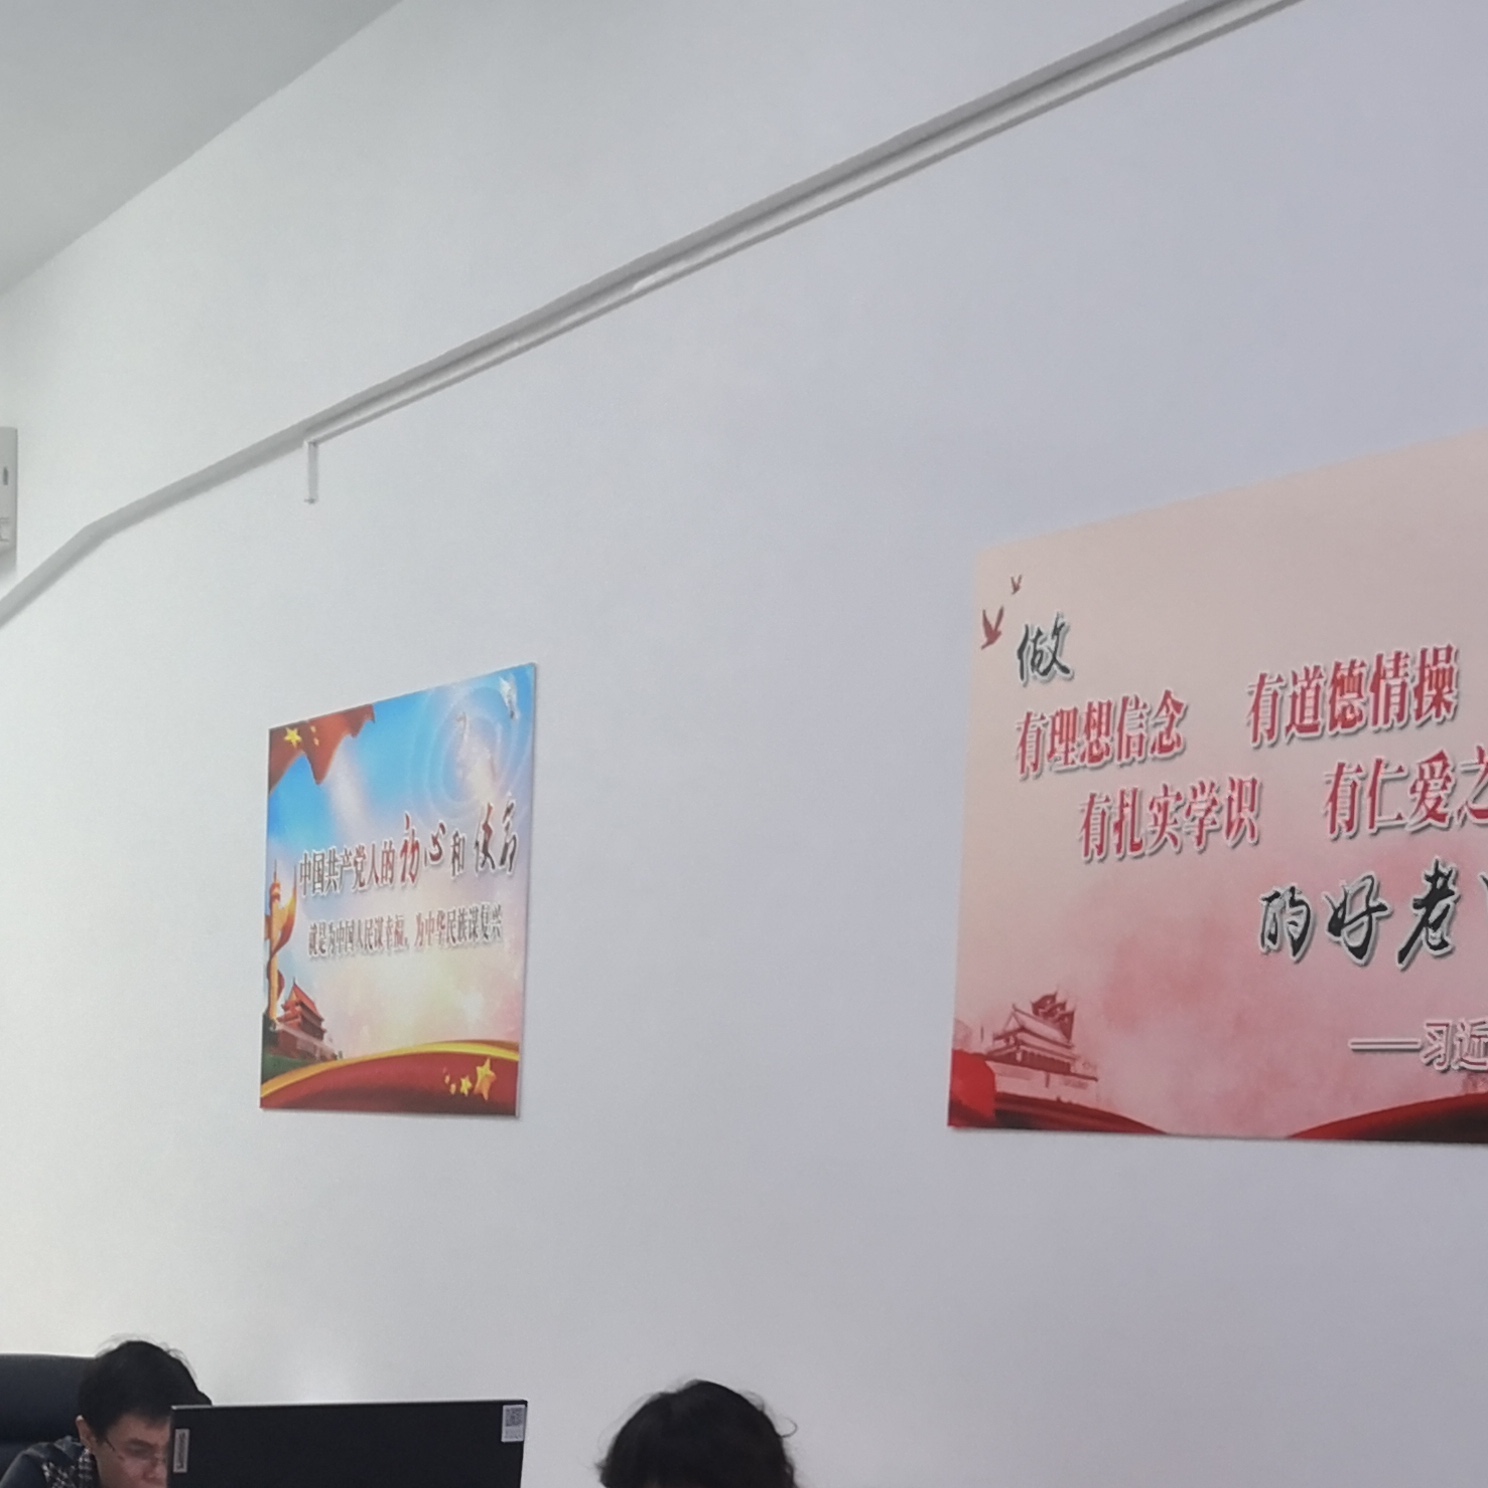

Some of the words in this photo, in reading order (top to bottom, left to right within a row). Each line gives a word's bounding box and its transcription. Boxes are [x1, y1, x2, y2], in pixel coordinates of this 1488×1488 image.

[1015, 613, 1072, 682] 做
[1015, 690, 1187, 778] 有理想信念
[1247, 643, 1458, 746] 有道德情操
[1079, 774, 1261, 861] 有扎实学识
[1324, 746, 1488, 837] 有仁爱之
[1259, 857, 1488, 967] 的好老
